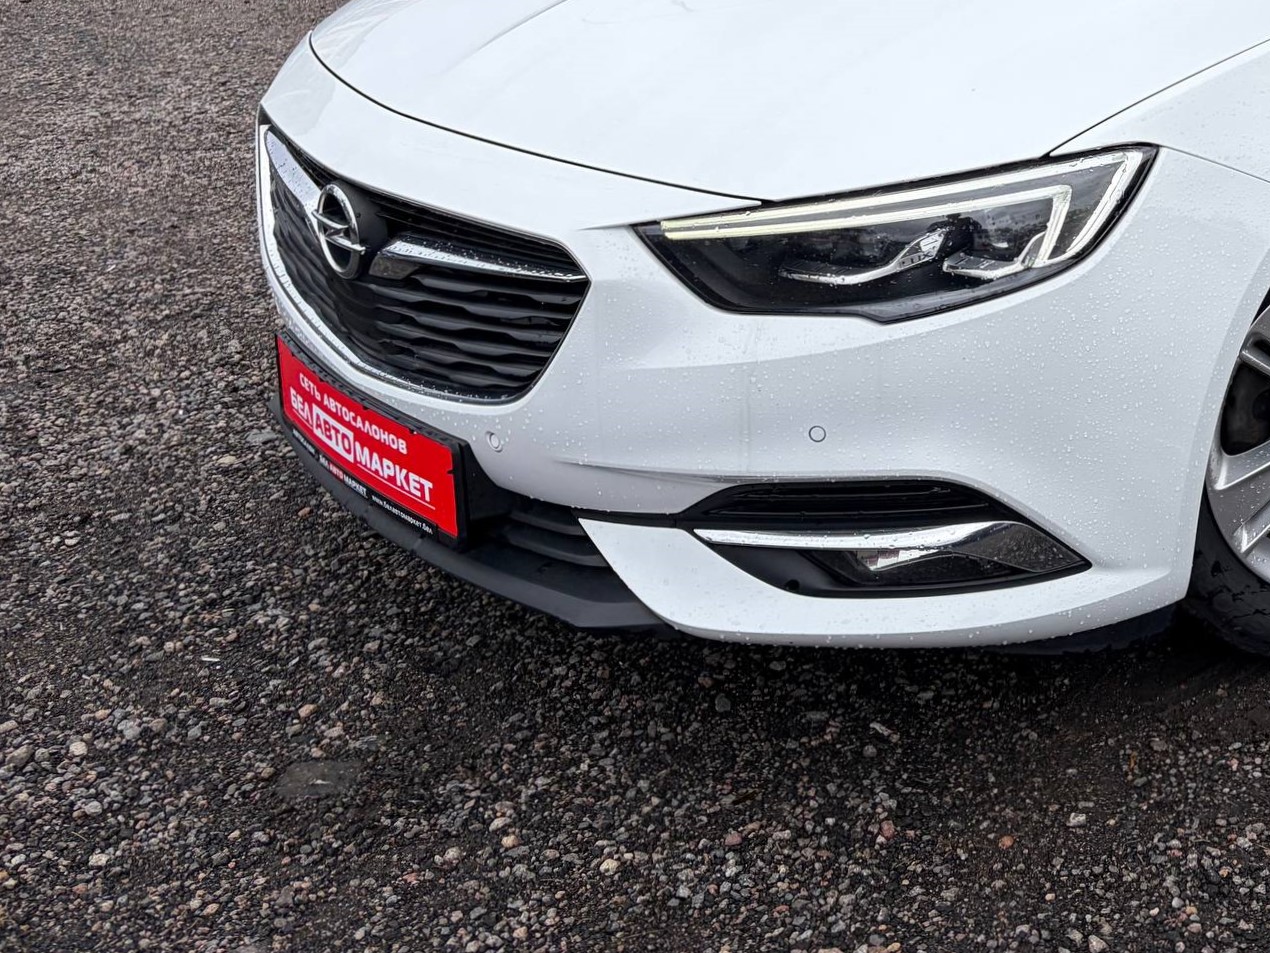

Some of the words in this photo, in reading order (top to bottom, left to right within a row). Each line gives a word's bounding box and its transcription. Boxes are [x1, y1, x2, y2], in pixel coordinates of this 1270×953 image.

[289, 387, 313, 426] БЕЛ
[315, 414, 352, 455] АВТО
[355, 441, 433, 503] МАРКЕТ
[299, 373, 321, 400] СЕТЬ
[323, 393, 407, 455] АВТОСАЛОНОВ
